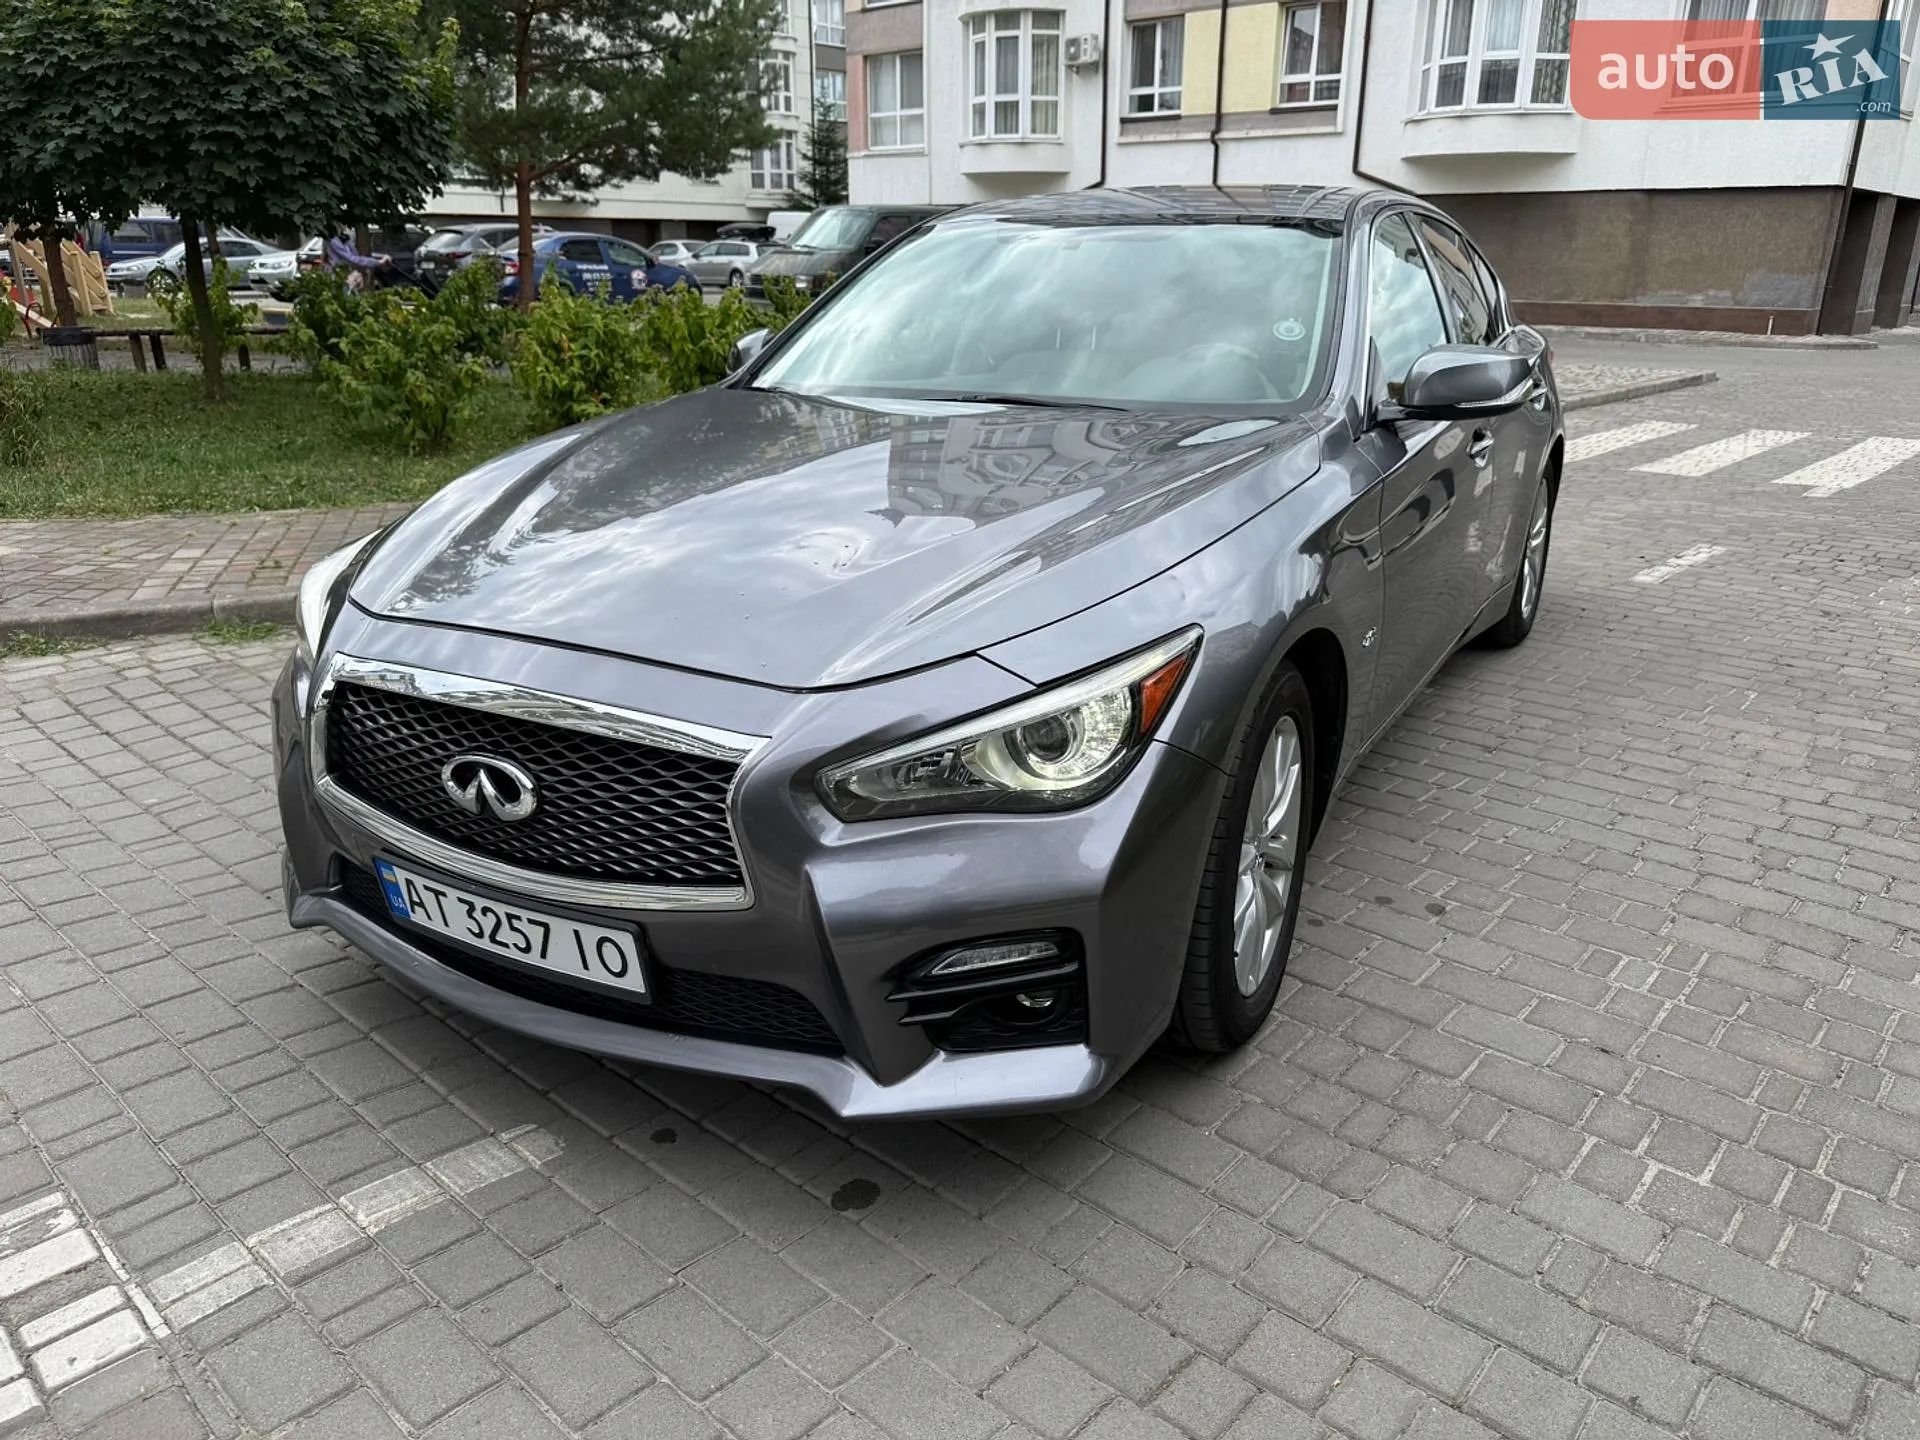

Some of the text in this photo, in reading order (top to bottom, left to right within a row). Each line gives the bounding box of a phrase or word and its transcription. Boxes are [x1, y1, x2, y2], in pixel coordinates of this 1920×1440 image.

[404, 877, 629, 979] AT 3257 IO
